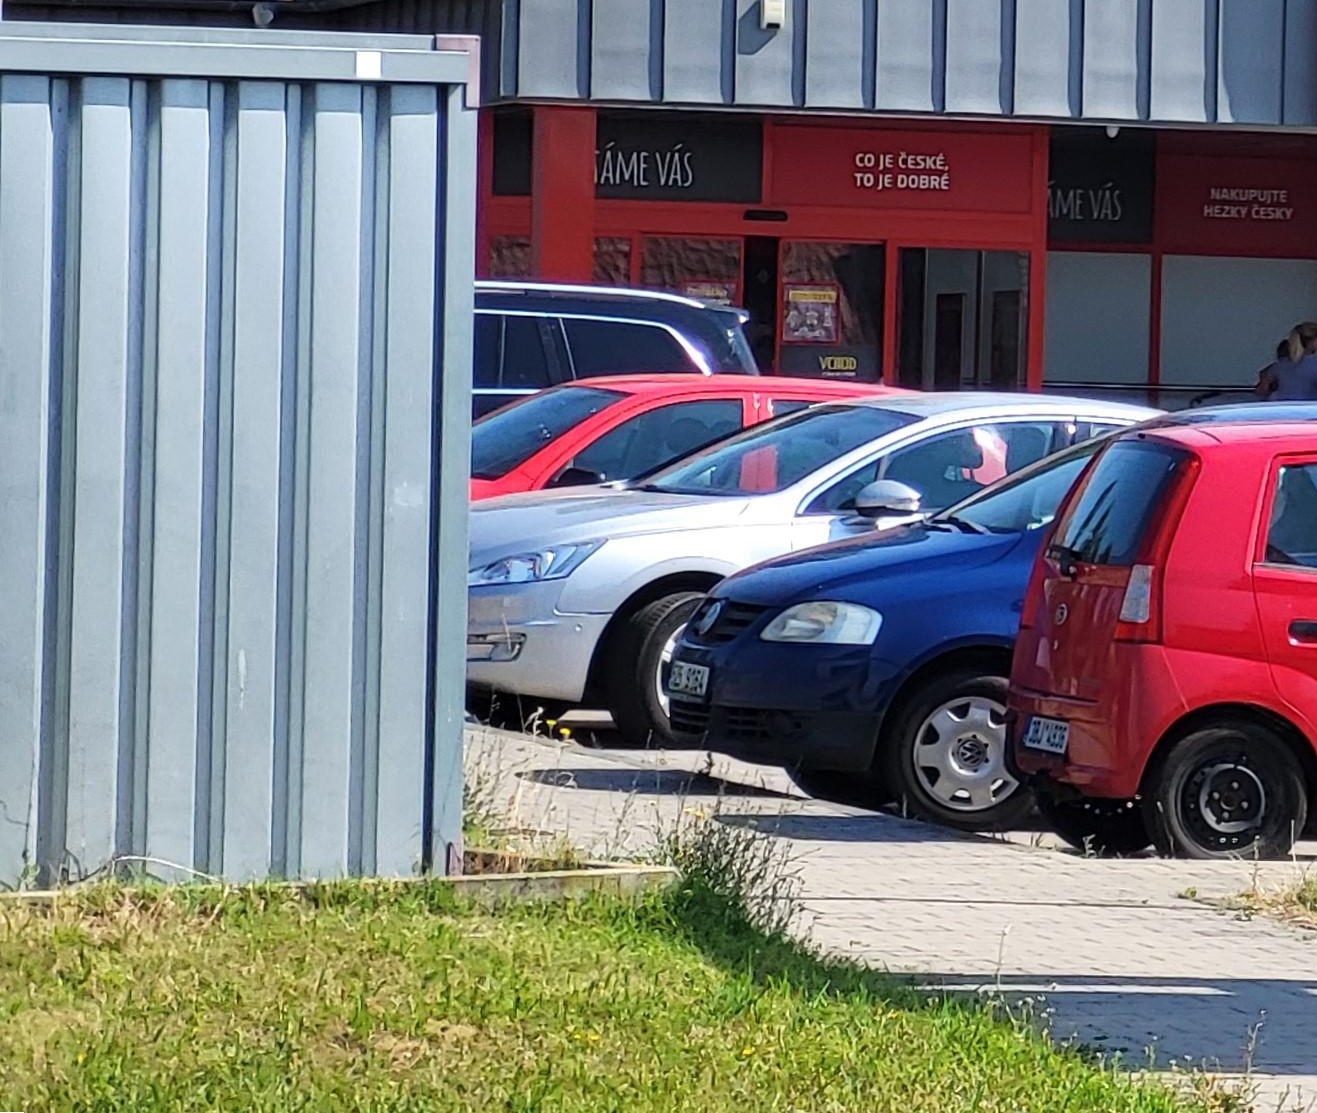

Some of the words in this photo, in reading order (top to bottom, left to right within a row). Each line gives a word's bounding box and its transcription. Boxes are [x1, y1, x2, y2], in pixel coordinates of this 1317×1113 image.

[656, 143, 693, 187] VÁS
[855, 153, 874, 168] CO
[878, 154, 894, 169] JE
[899, 152, 949, 172] ČESKÉ,
[854, 172, 874, 186] TO
[878, 173, 894, 189] JE
[898, 172, 949, 190] DOBRÉ
[1090, 181, 1121, 220] VÁS
[1210, 188, 1287, 203] NAKUPUJTE
[1204, 205, 1248, 219] HEZKY
[1252, 205, 1293, 220] ČESKY
